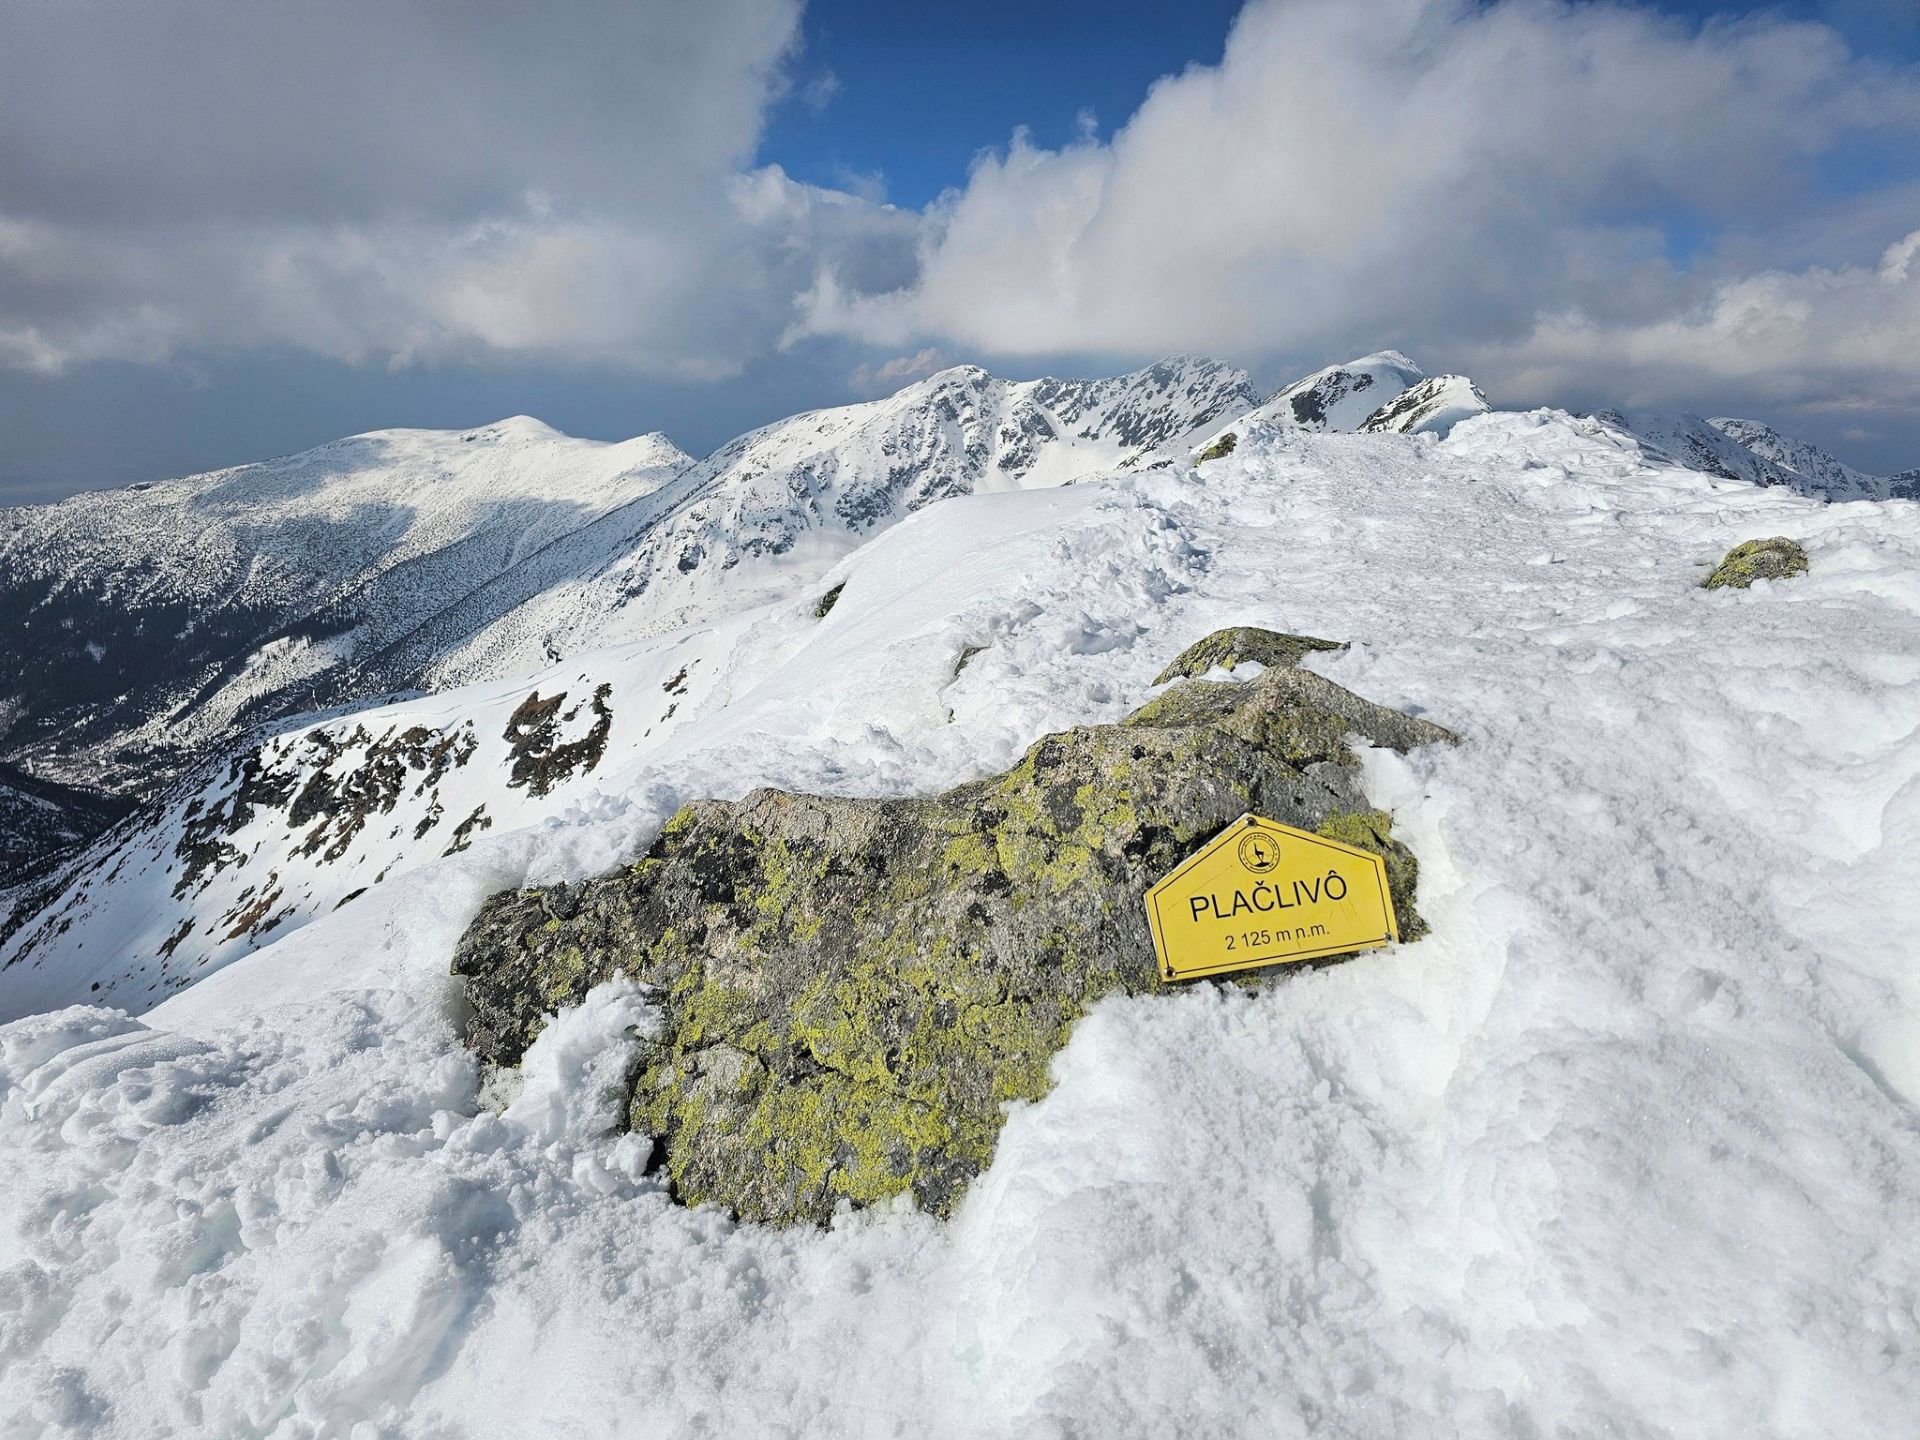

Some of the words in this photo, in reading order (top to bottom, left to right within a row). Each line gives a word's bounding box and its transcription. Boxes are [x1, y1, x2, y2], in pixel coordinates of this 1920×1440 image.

[1189, 869, 1348, 923] PLAČLIVÔ
[1225, 935, 1236, 950] 2
[1241, 929, 1271, 948] 125
